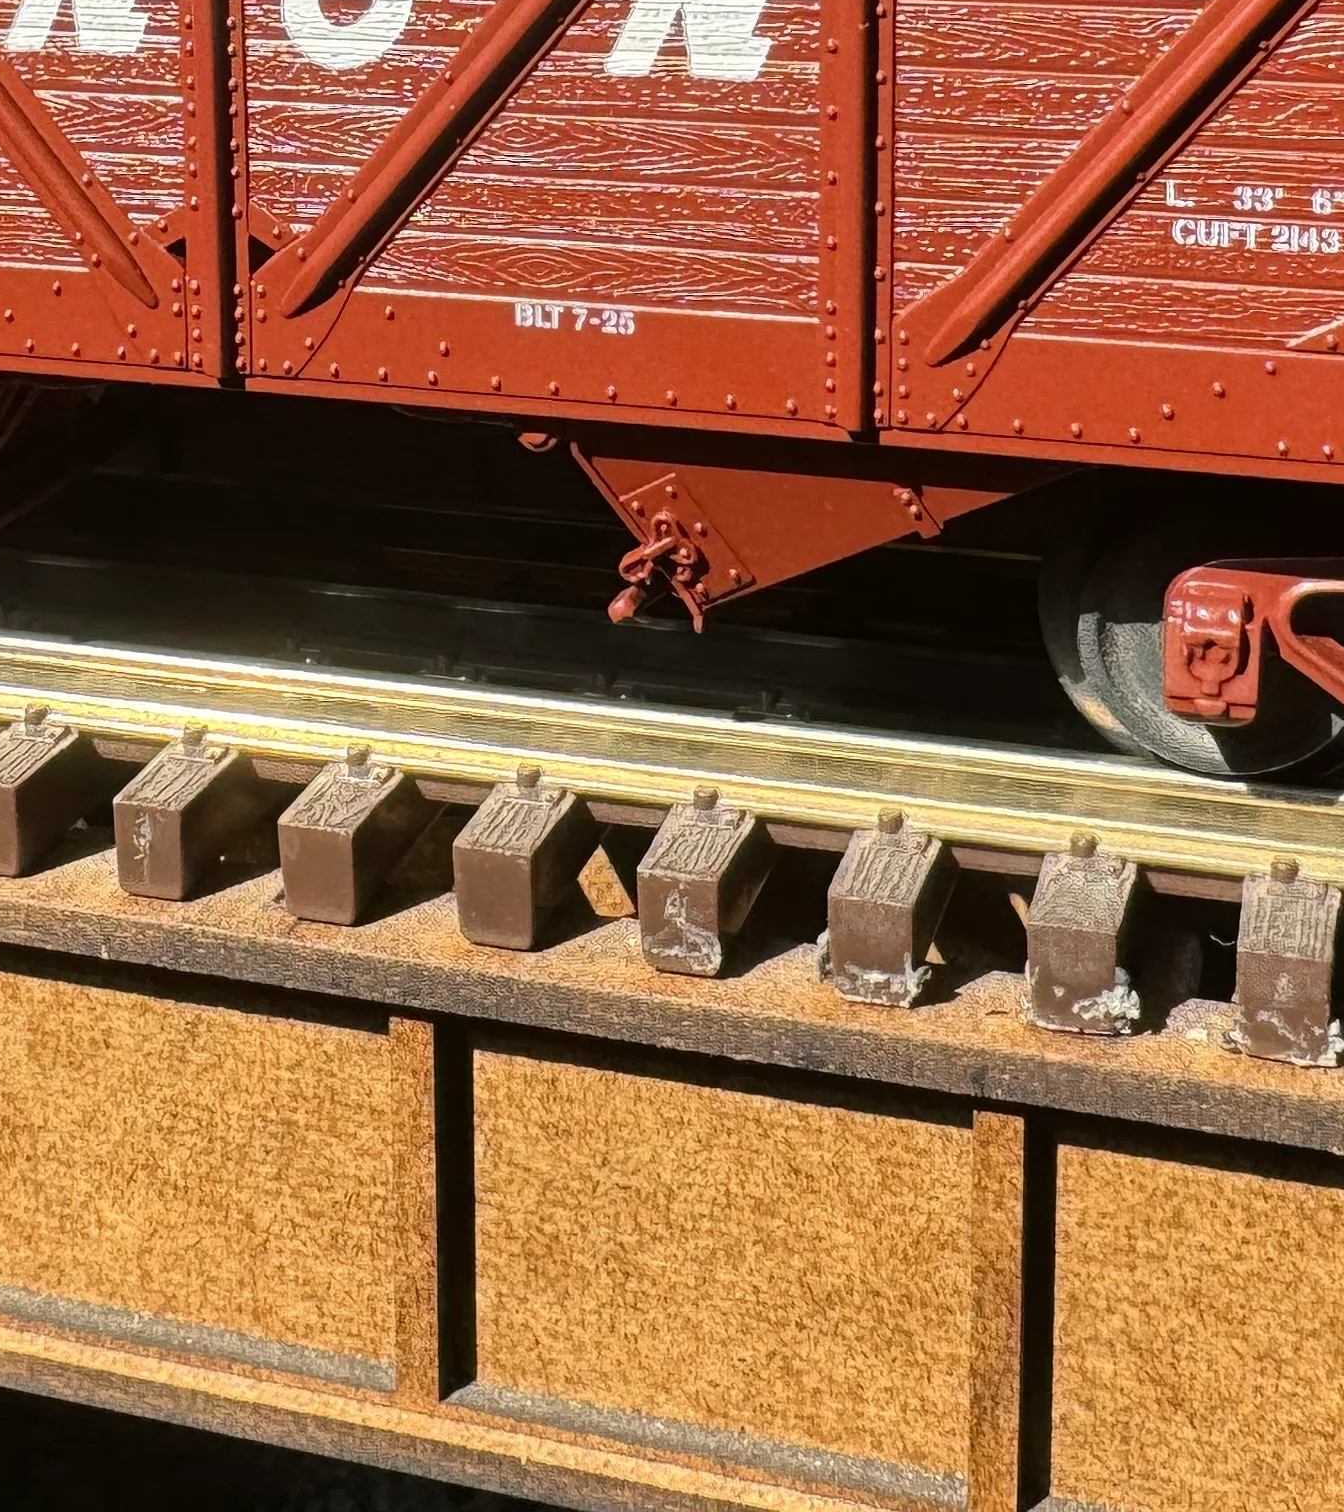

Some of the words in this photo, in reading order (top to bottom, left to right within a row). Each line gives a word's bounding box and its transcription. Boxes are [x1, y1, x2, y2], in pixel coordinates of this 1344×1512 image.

[1270, 225, 1341, 254] 2143
[514, 301, 564, 330] BLT
[571, 307, 636, 335] 7-25
